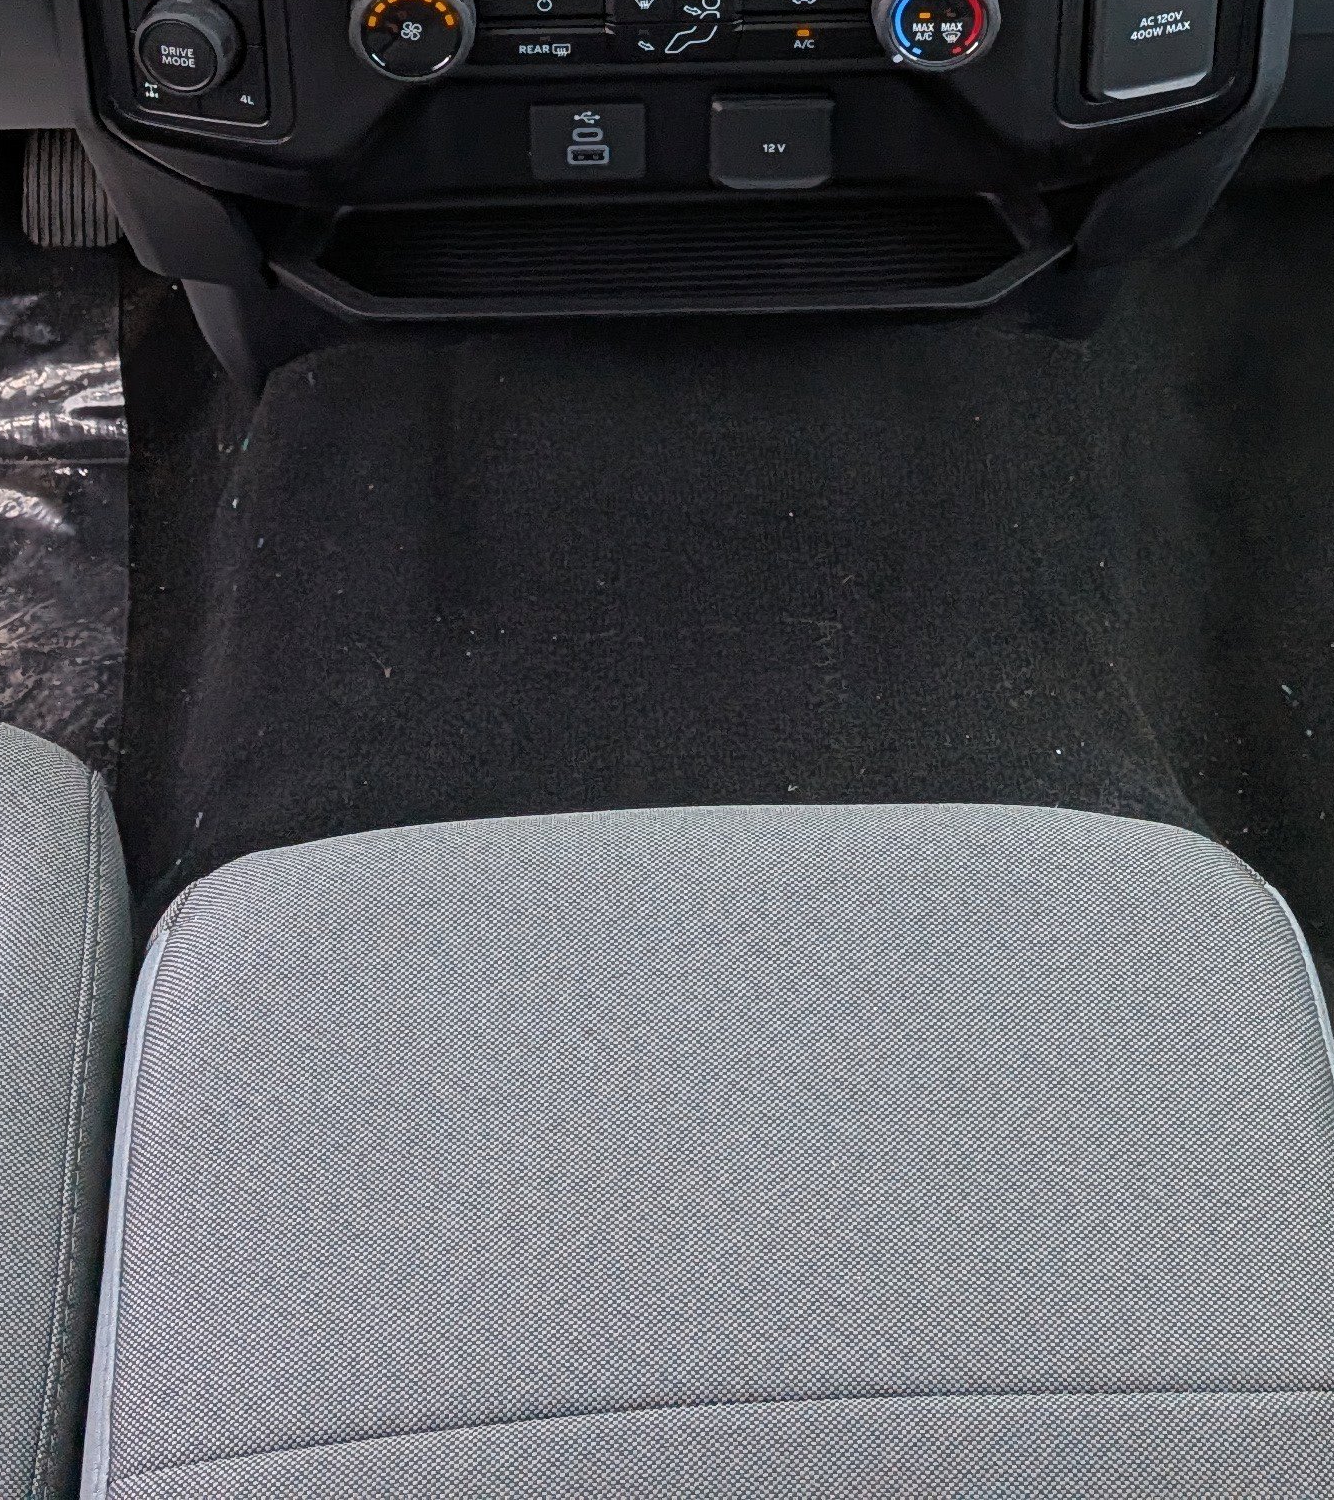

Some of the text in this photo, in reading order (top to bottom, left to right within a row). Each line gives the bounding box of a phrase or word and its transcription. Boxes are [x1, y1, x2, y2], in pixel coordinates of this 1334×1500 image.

[1139, 10, 1183, 28] AC 120V
[912, 22, 935, 32] MAX
[940, 22, 964, 32] MAX
[1130, 20, 1191, 41] 400W MAX
[914, 31, 933, 41] A/C
[518, 44, 551, 56] REAR
[793, 38, 816, 50] A/C
[160, 44, 195, 59] DRIVE
[161, 55, 196, 68] MODE
[239, 94, 255, 106] 4L
[762, 142, 786, 154] 12 V
